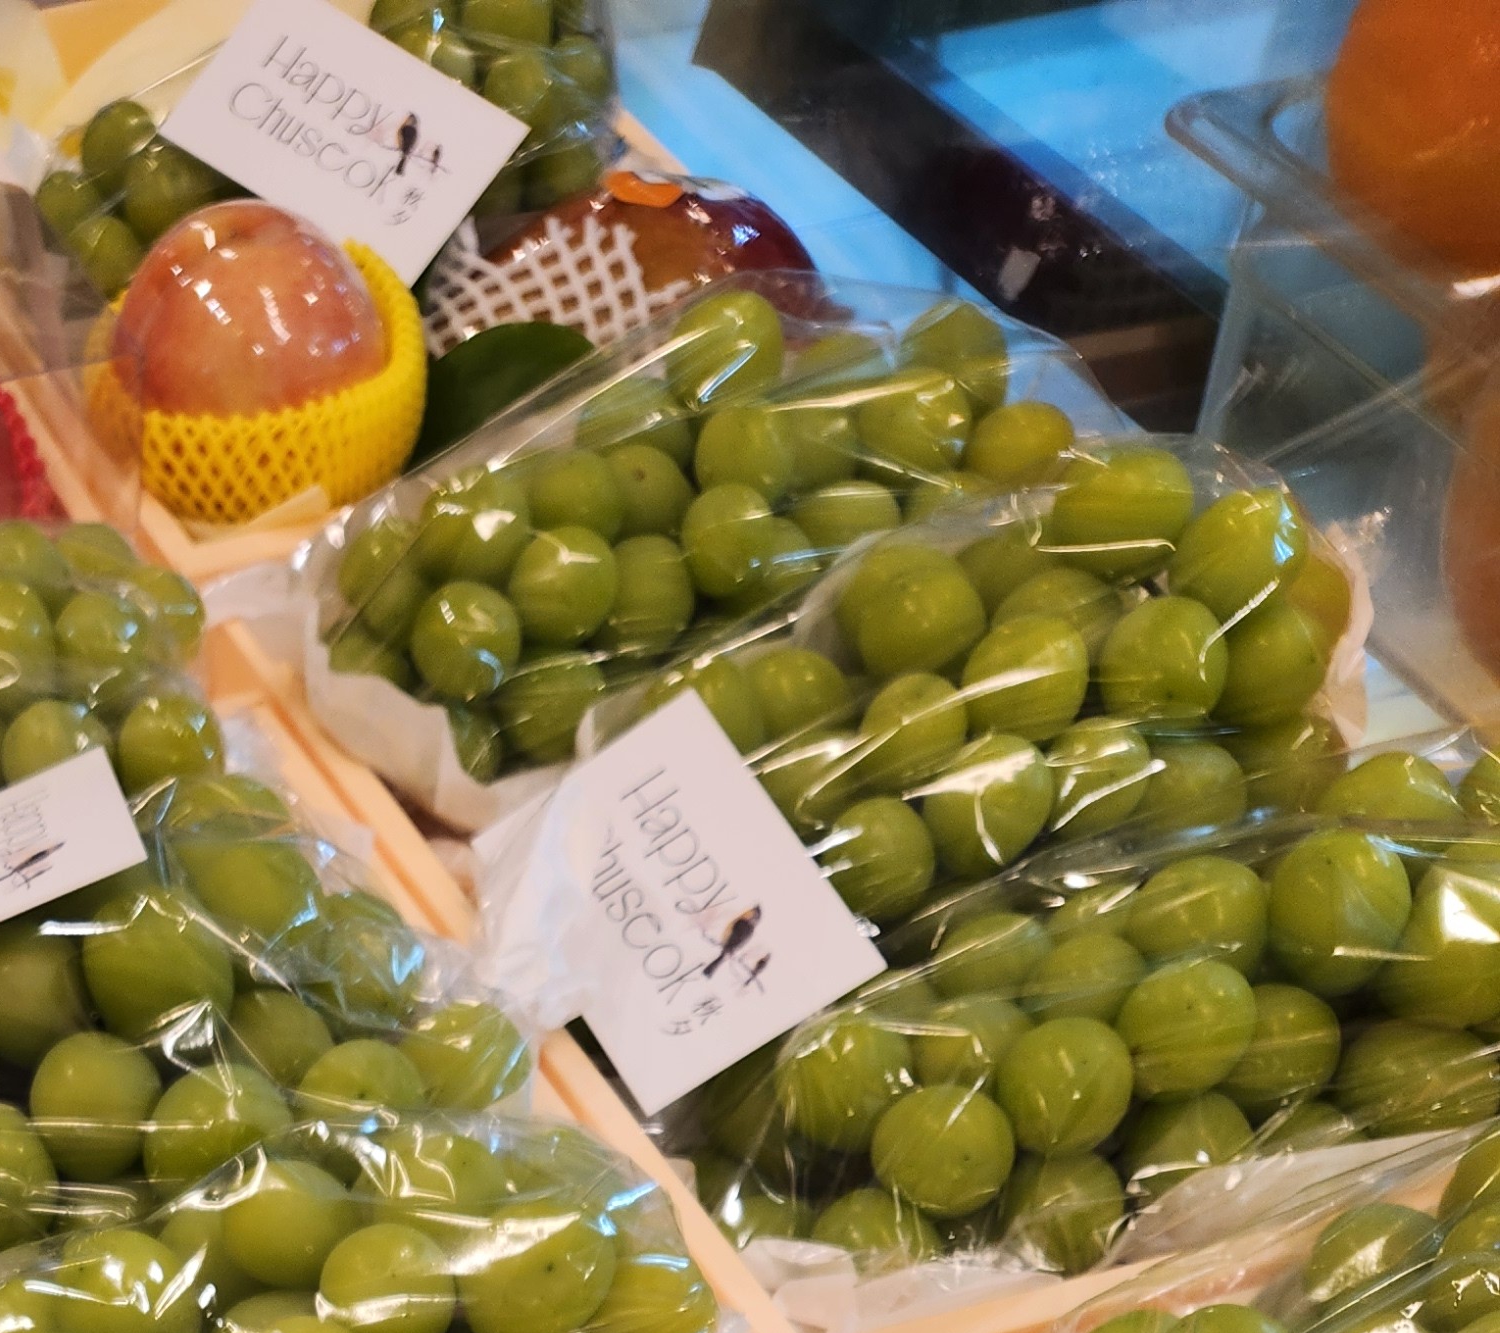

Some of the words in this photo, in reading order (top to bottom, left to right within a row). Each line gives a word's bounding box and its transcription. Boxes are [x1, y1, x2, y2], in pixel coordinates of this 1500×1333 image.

[229, 82, 399, 199] Chuseok
[262, 34, 392, 136] Happy
[621, 768, 739, 916] Happy
[592, 822, 704, 1006] huseok
